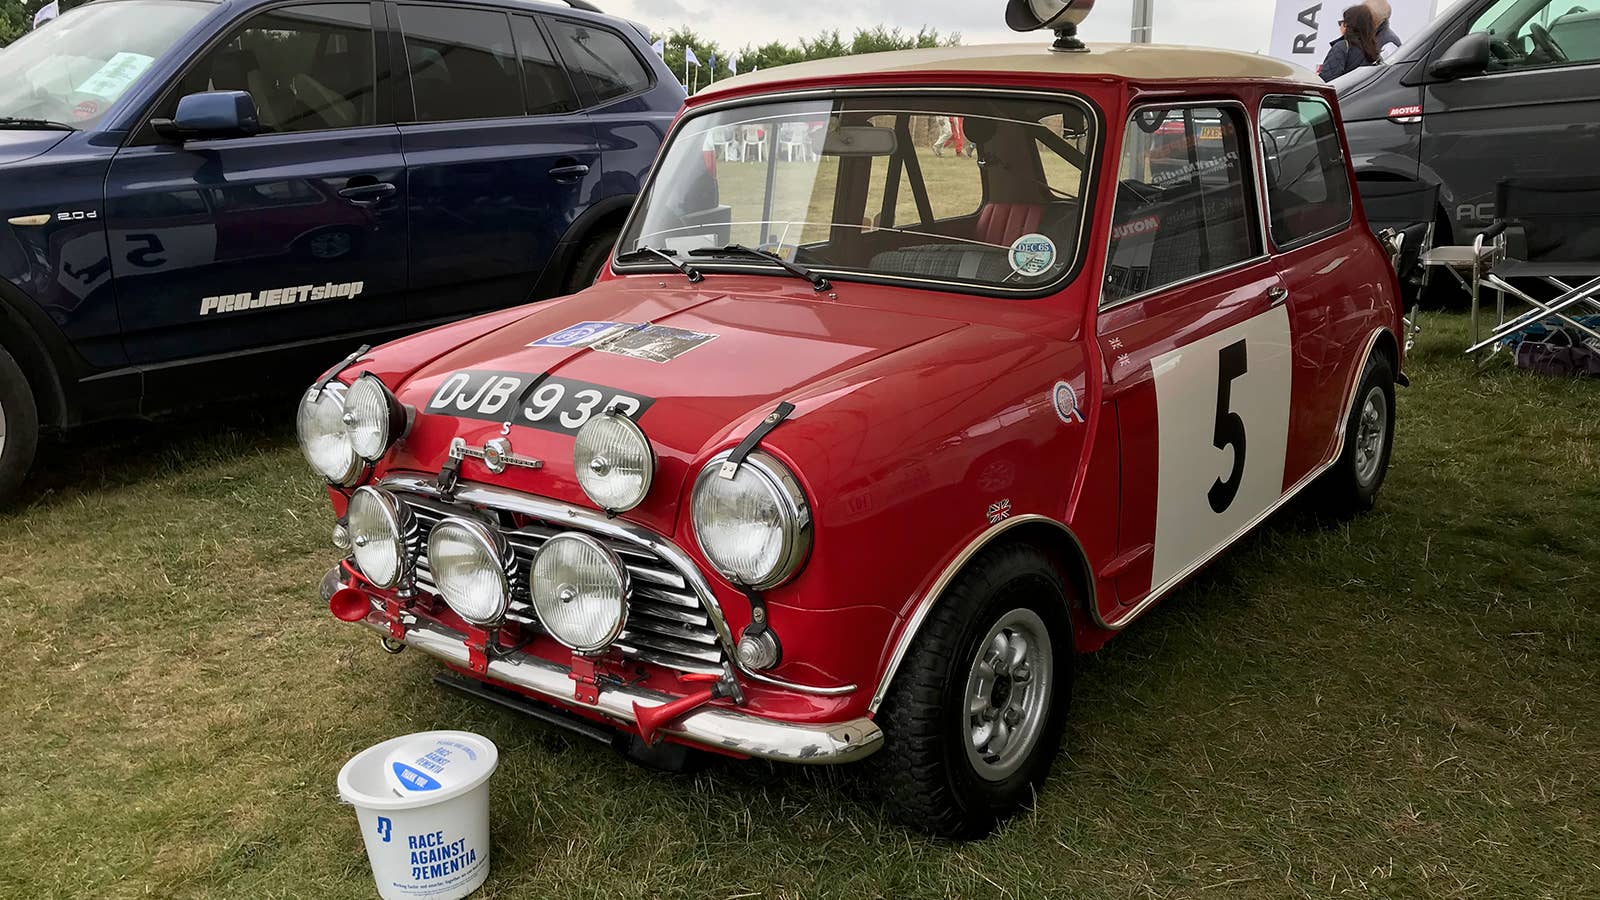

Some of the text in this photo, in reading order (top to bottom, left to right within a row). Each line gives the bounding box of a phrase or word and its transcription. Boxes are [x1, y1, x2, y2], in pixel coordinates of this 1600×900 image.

[1292, 2, 1322, 54] RA
[1390, 106, 1421, 116] MOTUL
[1018, 243, 1049, 252] DEC 65
[199, 280, 364, 316] PROJECTshop
[430, 373, 521, 415] DJB
[501, 421, 512, 435] S
[1208, 339, 1248, 514] 5
[408, 831, 444, 850] RACE
[411, 838, 466, 865] AGAINST
[412, 848, 476, 880] DEMENTIA
